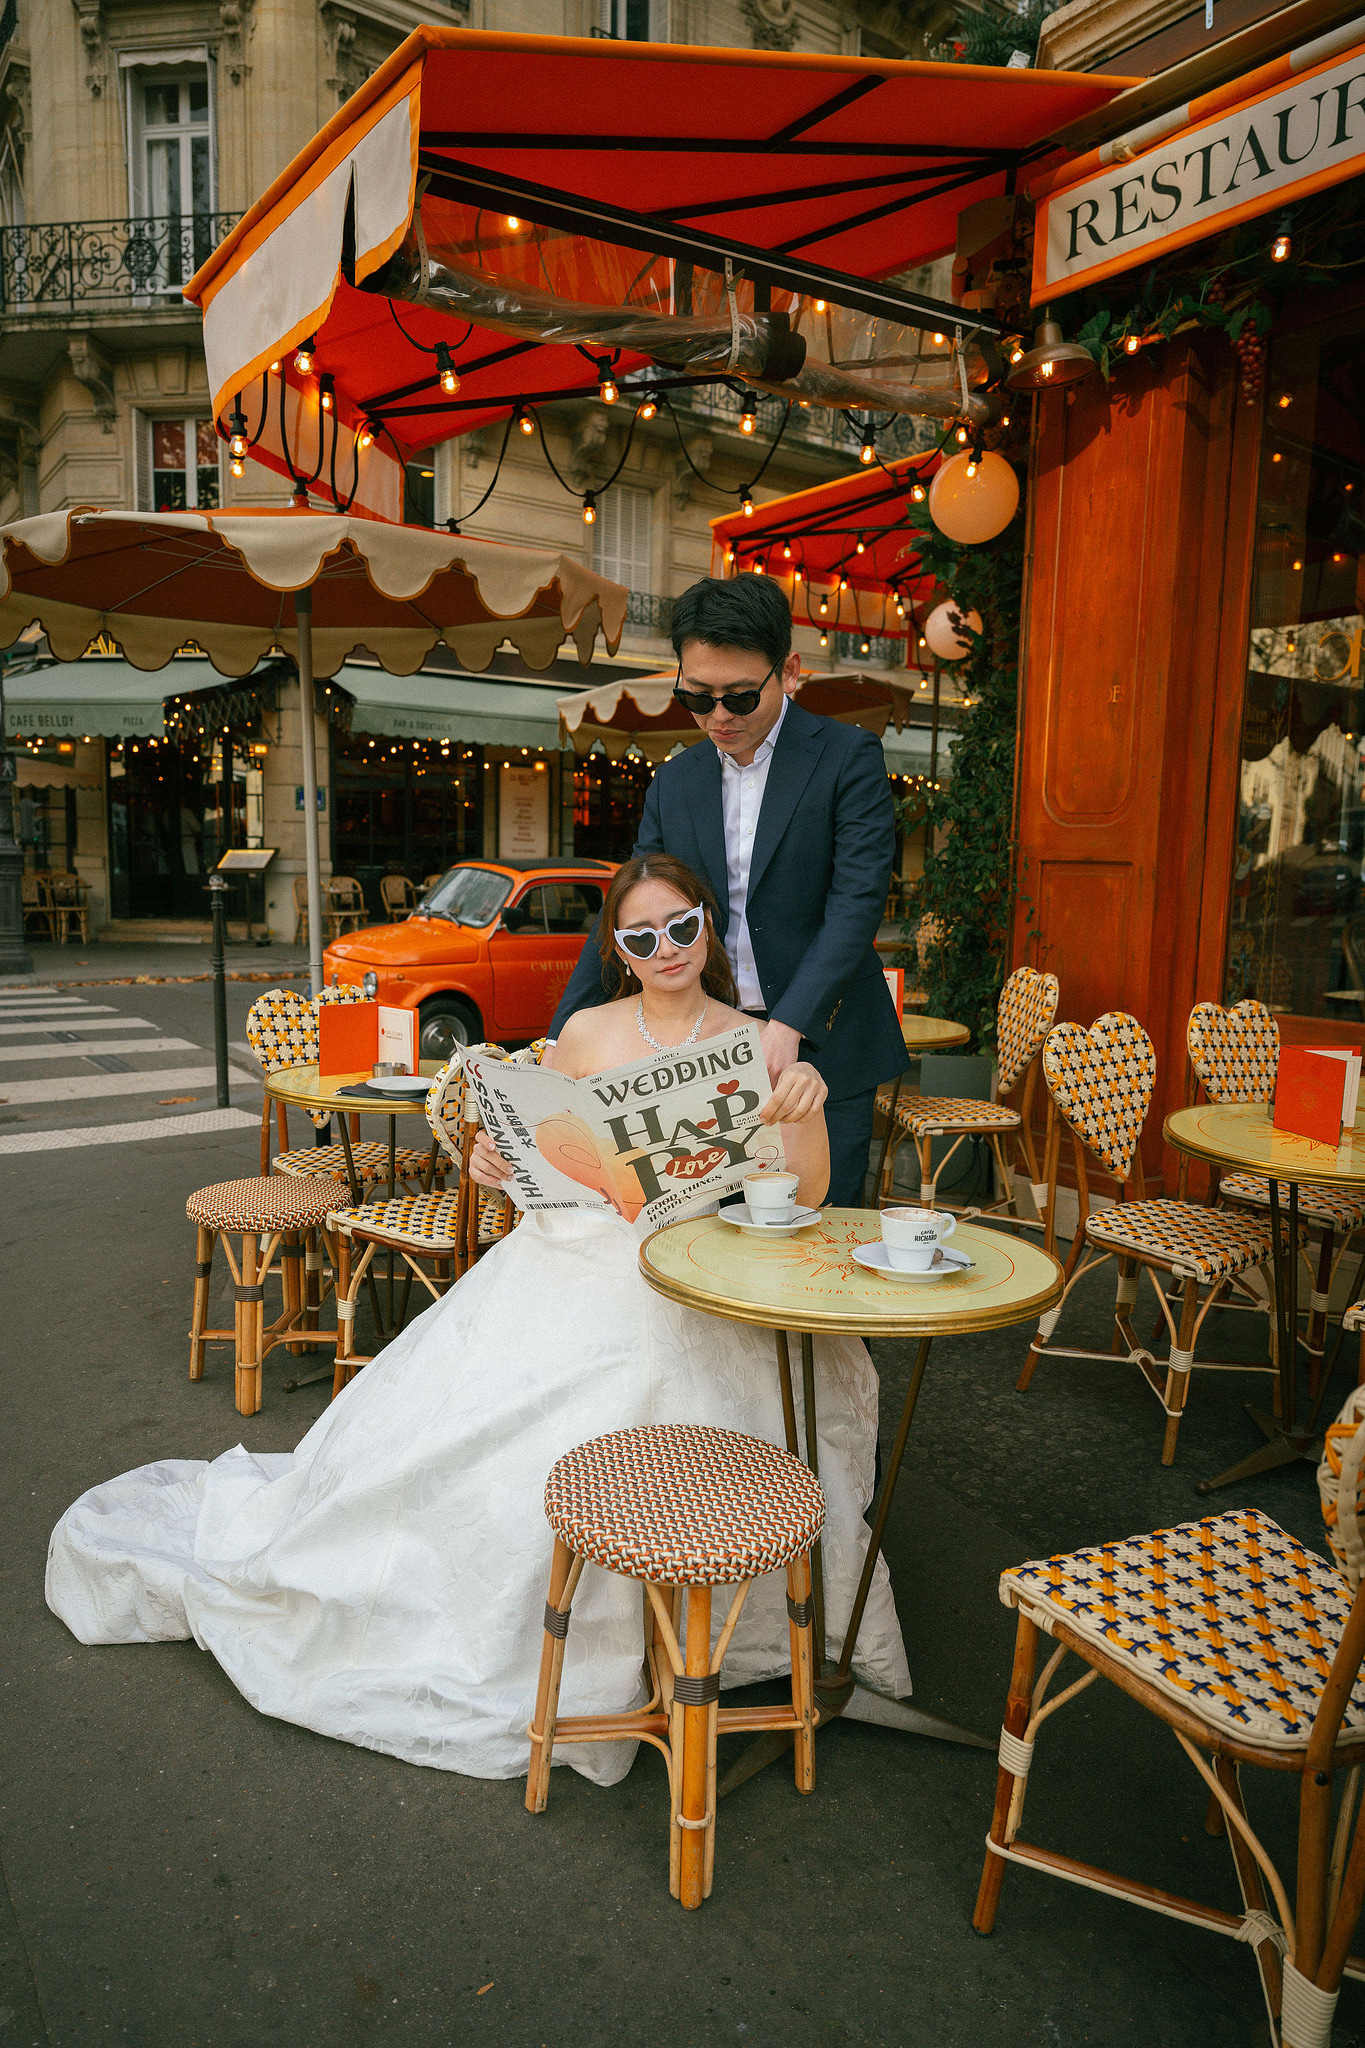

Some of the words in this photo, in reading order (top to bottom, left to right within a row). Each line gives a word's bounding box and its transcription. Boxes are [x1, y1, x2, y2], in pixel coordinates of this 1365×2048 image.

[38, 715, 73, 727] BELLOY
[592, 1041, 754, 1107] WEDDING
[672, 1150, 728, 1178] Love
[646, 1193, 678, 1216] GOOD
[680, 1173, 723, 1195] THINGS
[649, 1195, 692, 1223] HAPPEN
[914, 1234, 938, 1242] RICHARD
